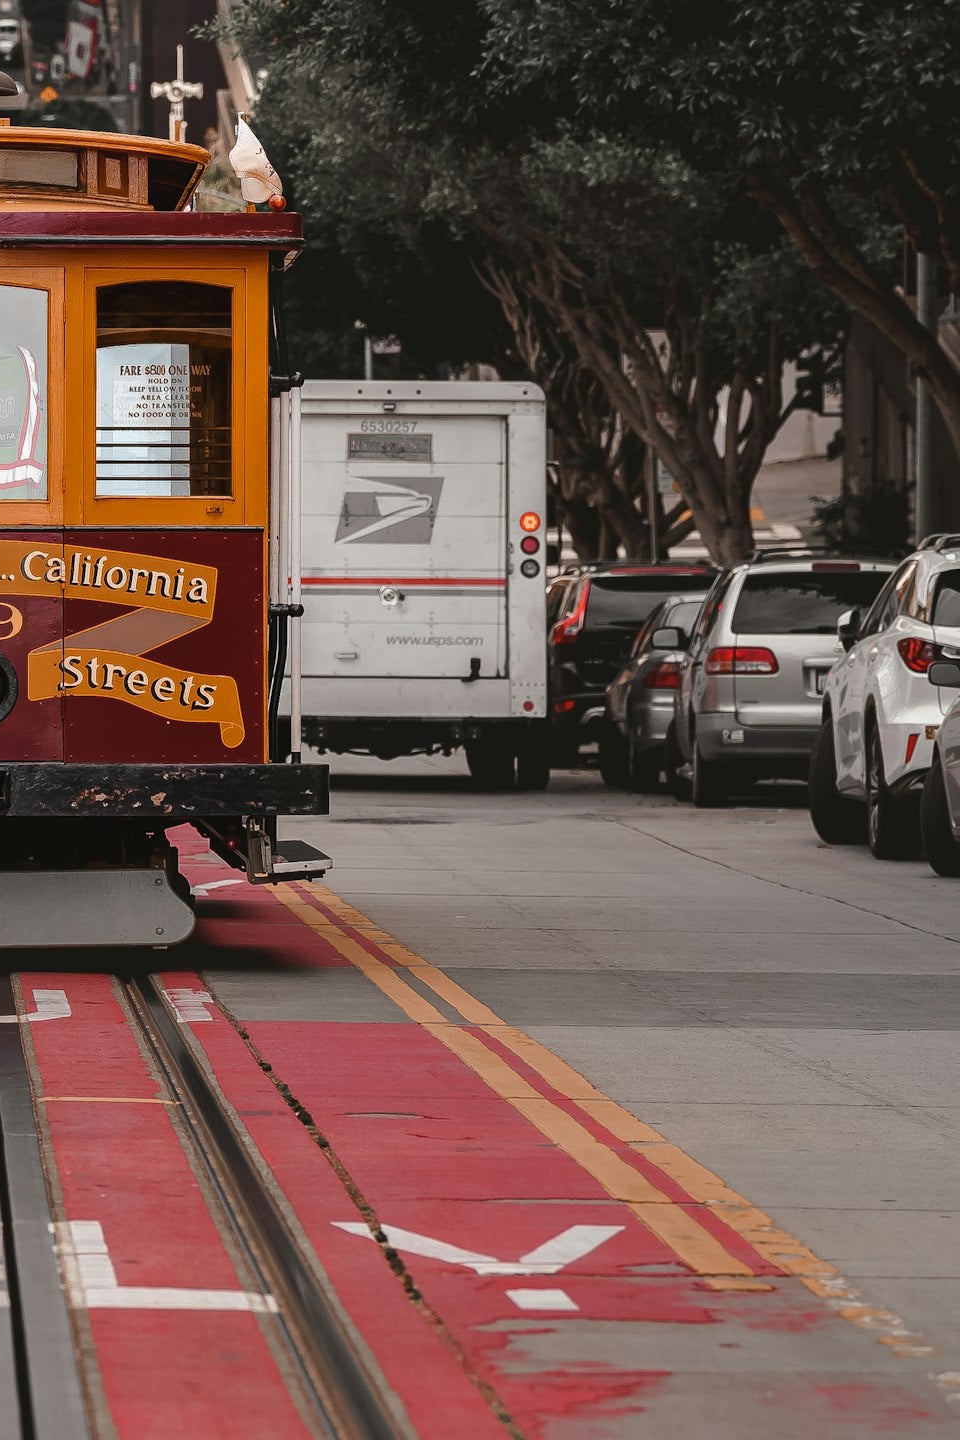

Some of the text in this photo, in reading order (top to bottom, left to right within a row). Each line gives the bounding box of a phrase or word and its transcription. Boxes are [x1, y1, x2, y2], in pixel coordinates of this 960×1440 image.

[120, 365, 142, 376] FARE
[168, 365, 188, 376] ONE
[191, 365, 211, 376] WAY
[360, 420, 418, 433] 6530257
[21, 550, 209, 604] California
[386, 635, 484, 648] www.usps.com
[58, 655, 218, 711] Streets
